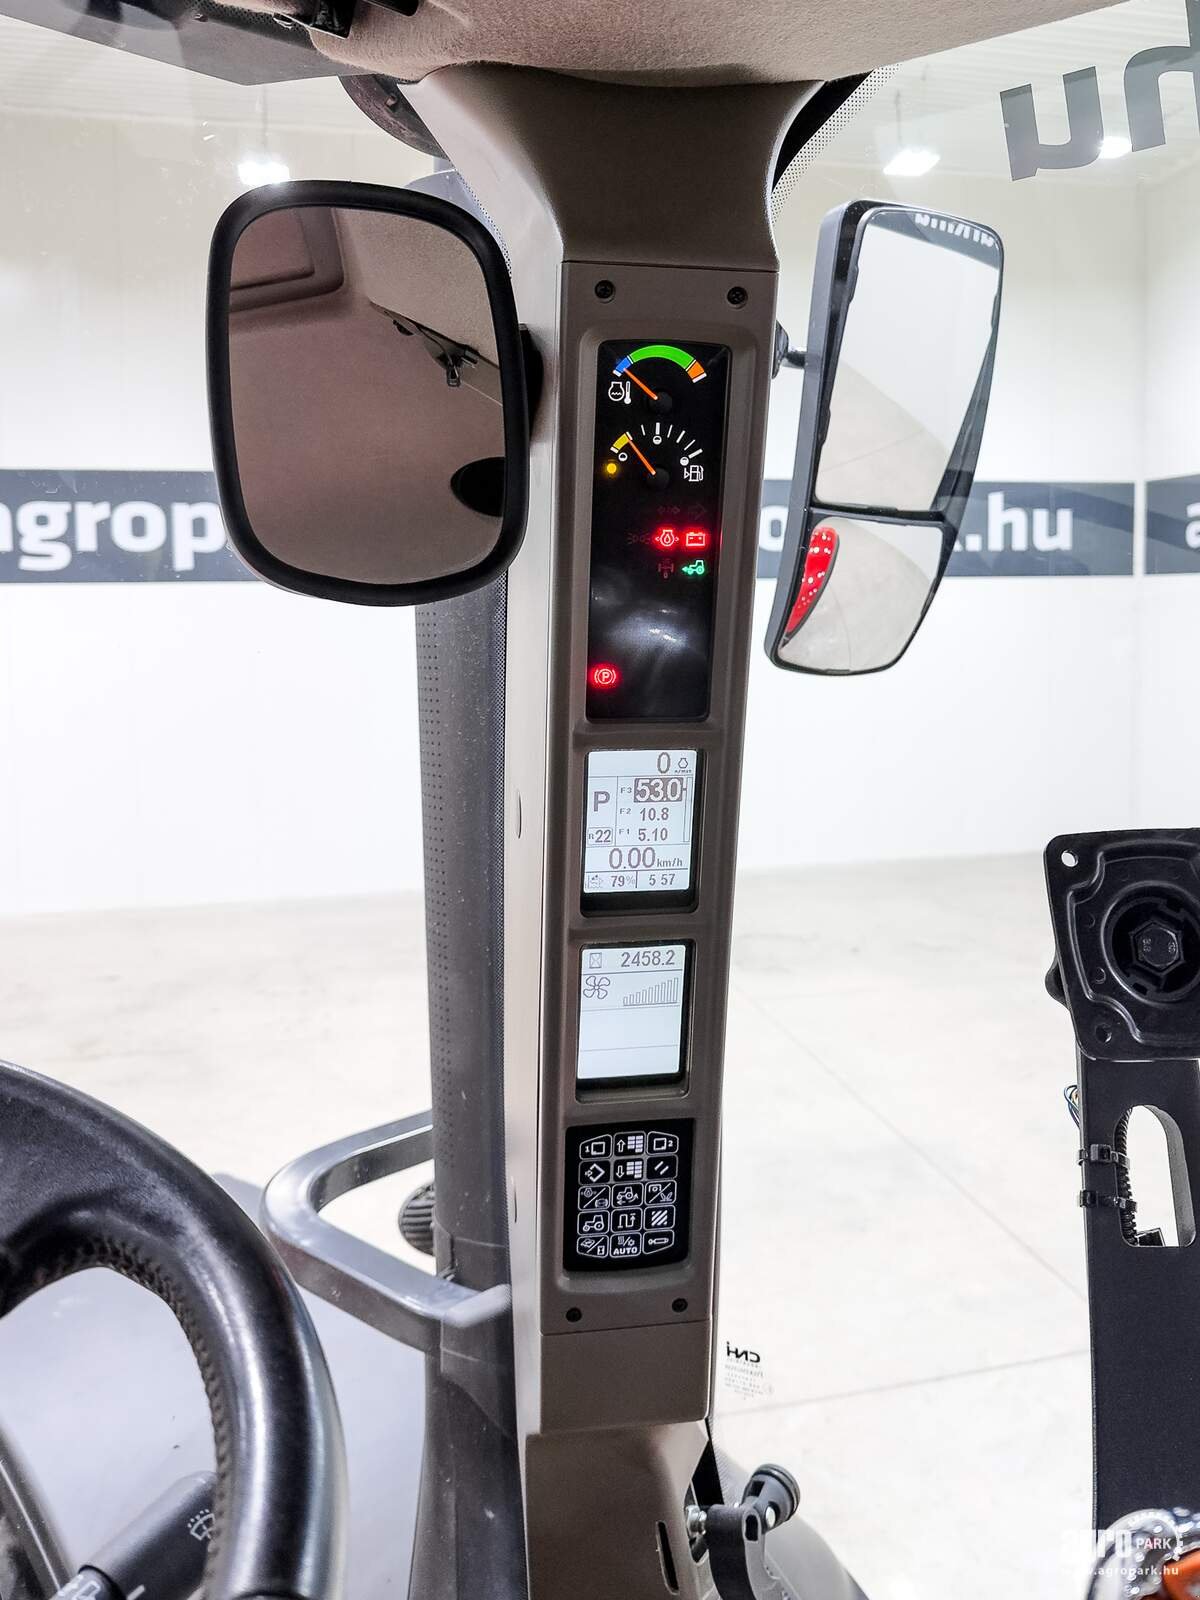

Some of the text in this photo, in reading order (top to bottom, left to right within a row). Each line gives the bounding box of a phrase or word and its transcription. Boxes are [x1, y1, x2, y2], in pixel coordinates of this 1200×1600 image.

[953, 491, 1073, 552] .hu
[0, 500, 228, 572] grop
[657, 752, 671, 773] 0
[635, 778, 682, 802] 53.0
[593, 791, 610, 812] P
[640, 807, 669, 821] 10.8
[638, 828, 668, 841] 5.10
[609, 847, 683, 869] 0.00 km/h
[621, 950, 675, 967] 2458.2
[613, 1247, 638, 1255] AUTO
